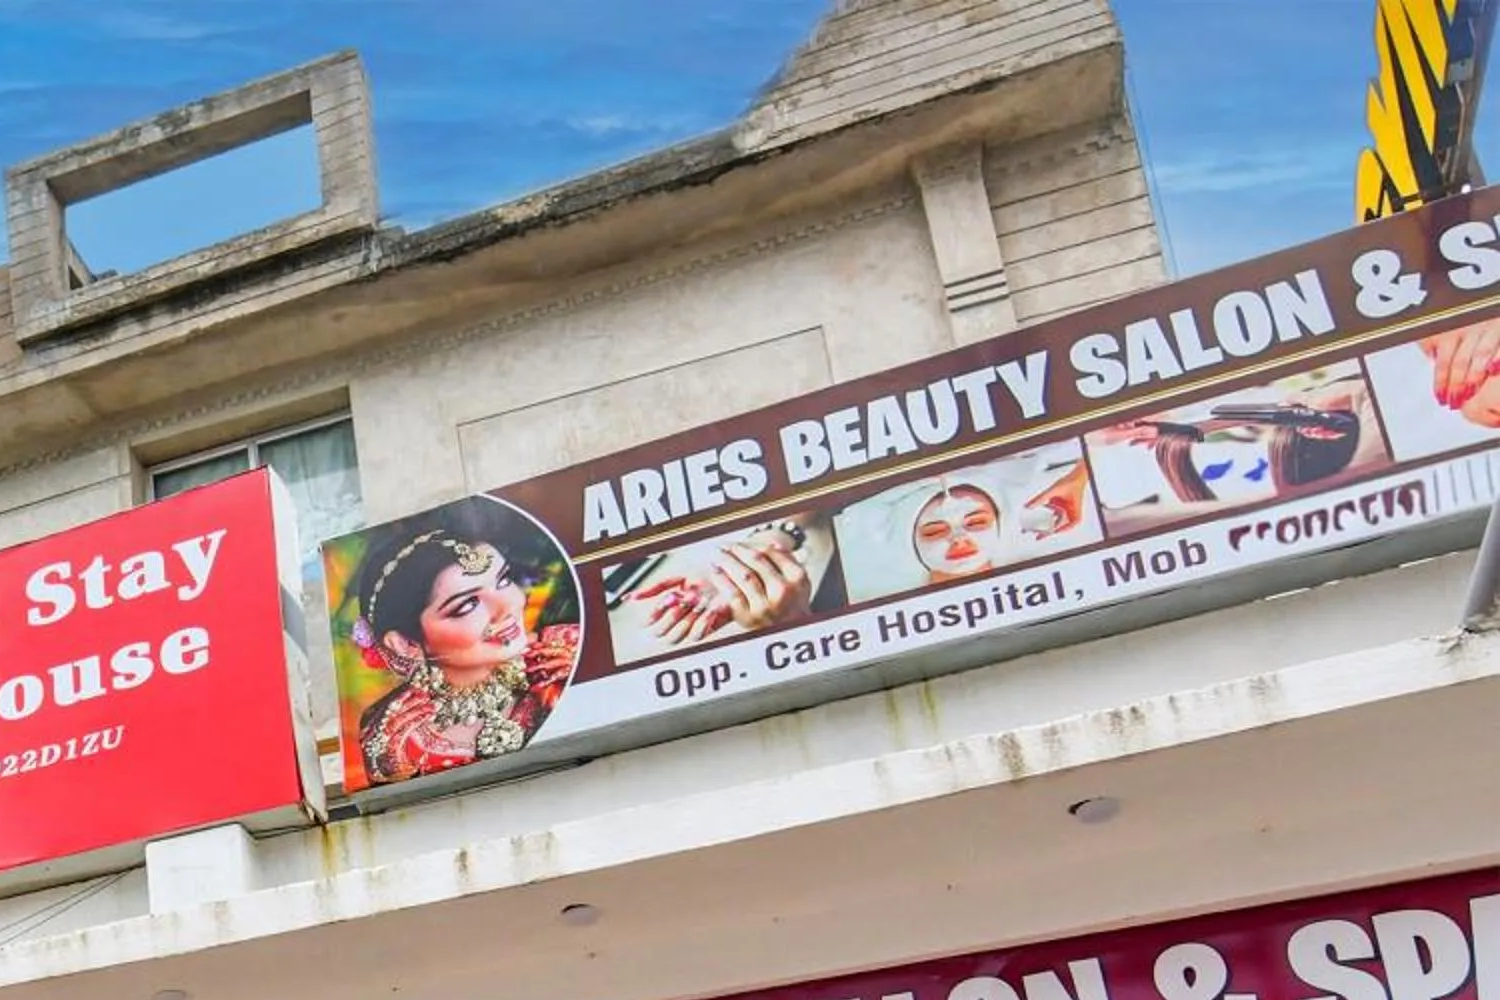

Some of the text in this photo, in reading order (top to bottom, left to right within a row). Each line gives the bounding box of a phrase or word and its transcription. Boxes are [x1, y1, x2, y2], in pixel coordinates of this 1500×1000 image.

[581, 214, 1500, 544] ARIES BEAUTY SALON & S
[24, 528, 228, 628] Stay
[764, 627, 862, 670] Care
[877, 567, 1085, 642] Hospital,
[1101, 537, 1208, 588] Mob
